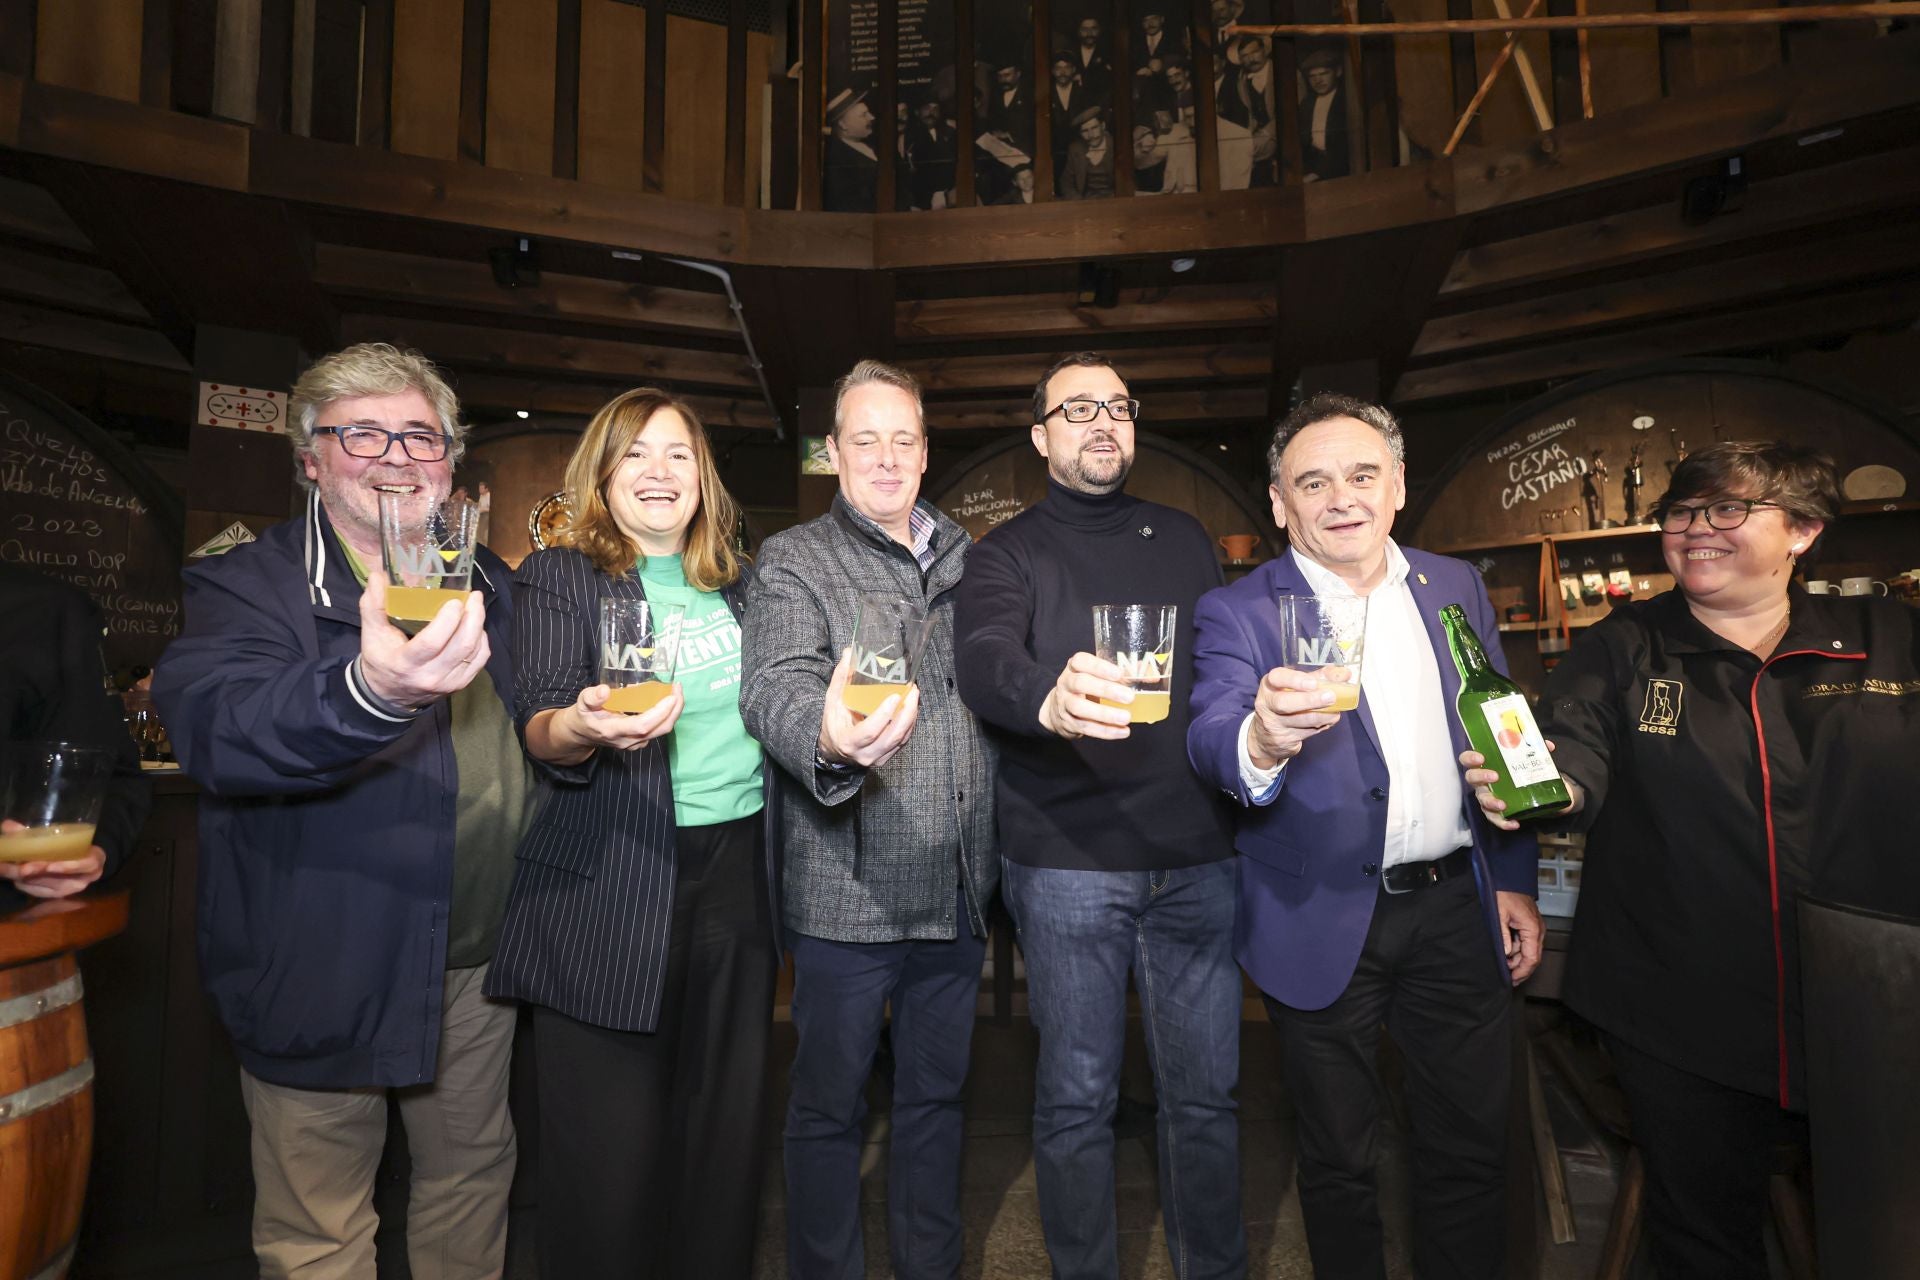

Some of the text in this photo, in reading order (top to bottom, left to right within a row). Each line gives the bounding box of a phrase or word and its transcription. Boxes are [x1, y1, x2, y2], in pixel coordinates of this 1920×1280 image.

[1487, 442, 1522, 463] PIEZAS
[39, 472, 63, 498] de
[1502, 456, 1587, 510] CASTAÑO
[963, 488, 994, 505] ALFAR
[951, 498, 1023, 520] TRADICIONAL
[11, 514, 103, 537] 2023
[88, 550, 126, 570] DOP
[1638, 580, 1650, 590] 16
[1638, 724, 1677, 736] aesa
